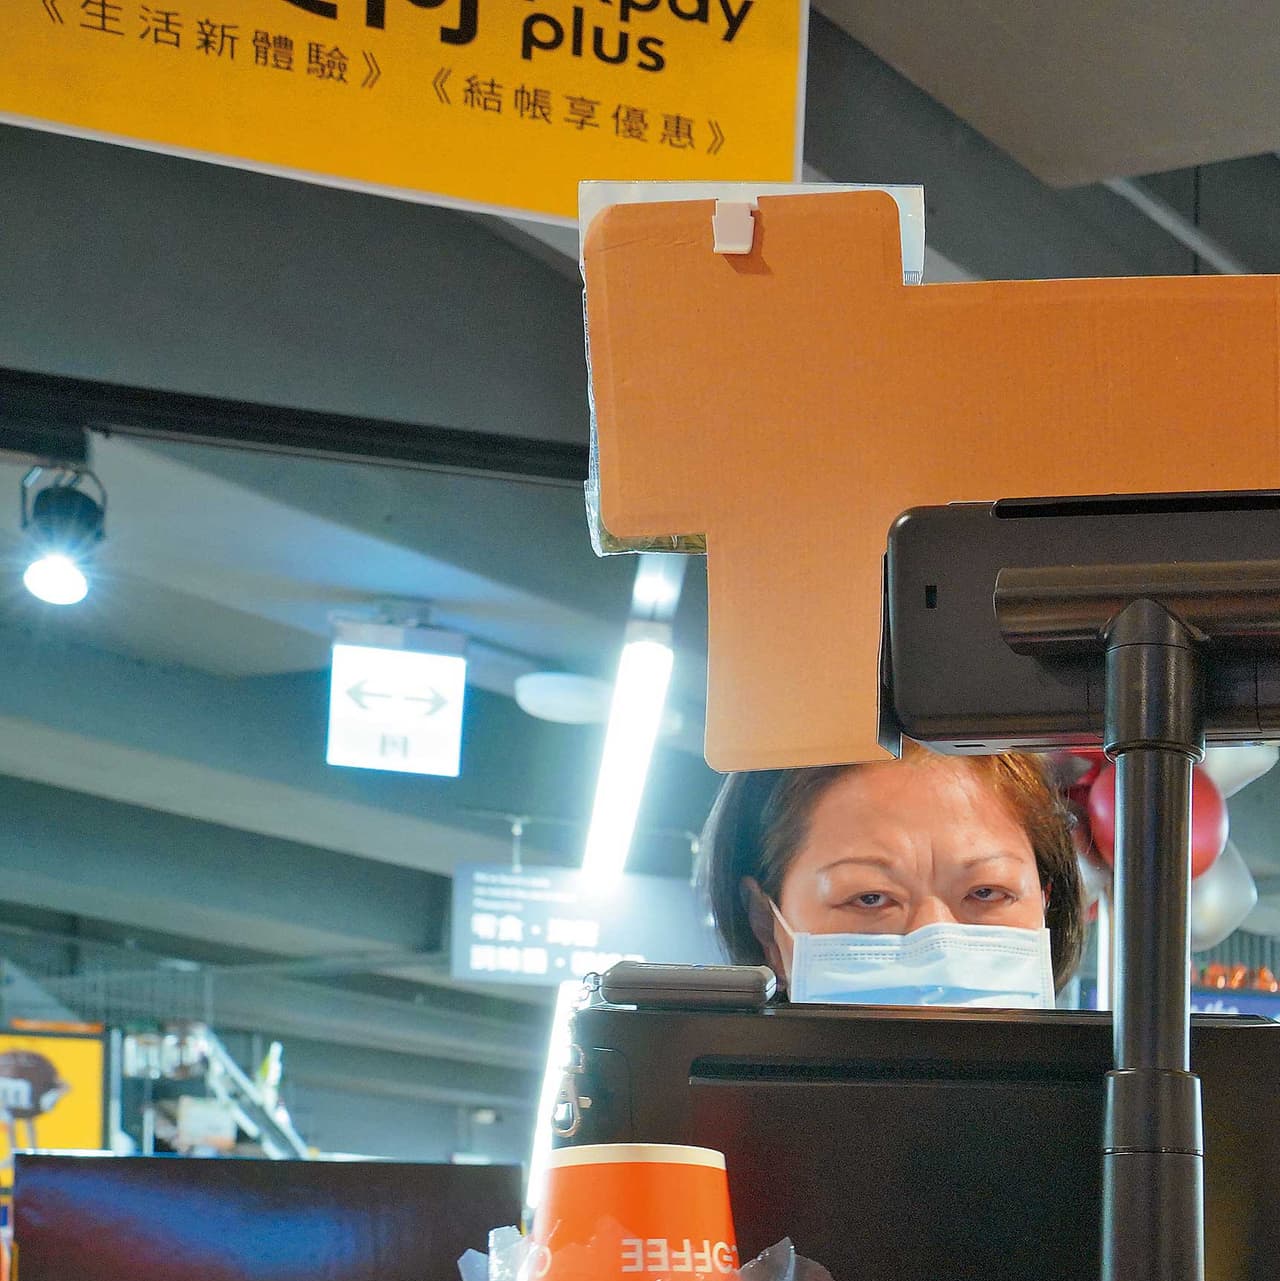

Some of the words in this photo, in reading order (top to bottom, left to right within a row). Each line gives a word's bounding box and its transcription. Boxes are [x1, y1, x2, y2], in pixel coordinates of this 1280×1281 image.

[521, 6, 665, 72] plus
[431, 66, 726, 156] 《結帳享優惠》
